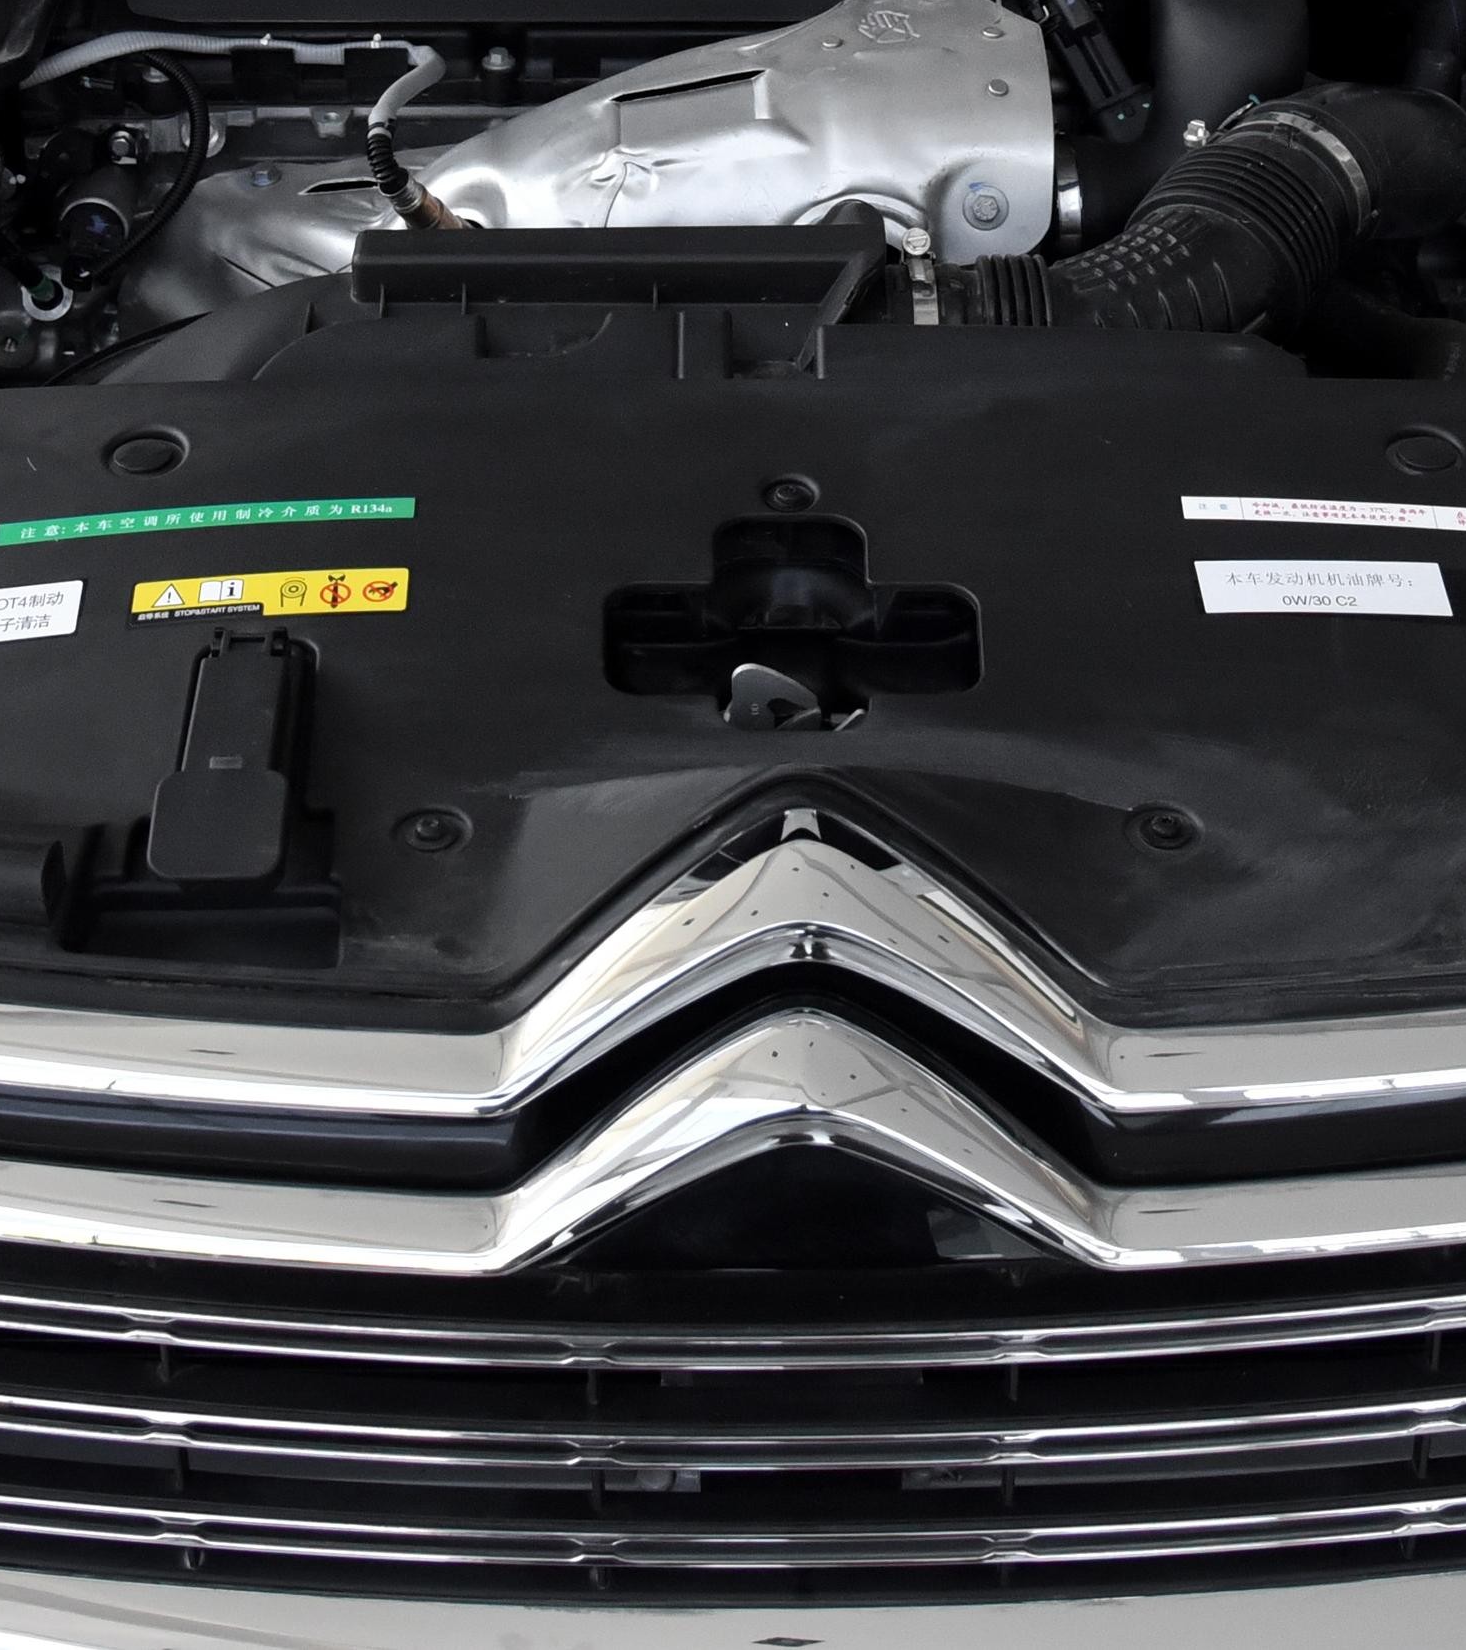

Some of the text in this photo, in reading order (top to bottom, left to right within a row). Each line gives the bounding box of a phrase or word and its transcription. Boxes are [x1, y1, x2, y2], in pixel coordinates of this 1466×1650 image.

[1282, 595, 1358, 607] 0W/30 C2
[227, 604, 260, 614] SYSTEM
